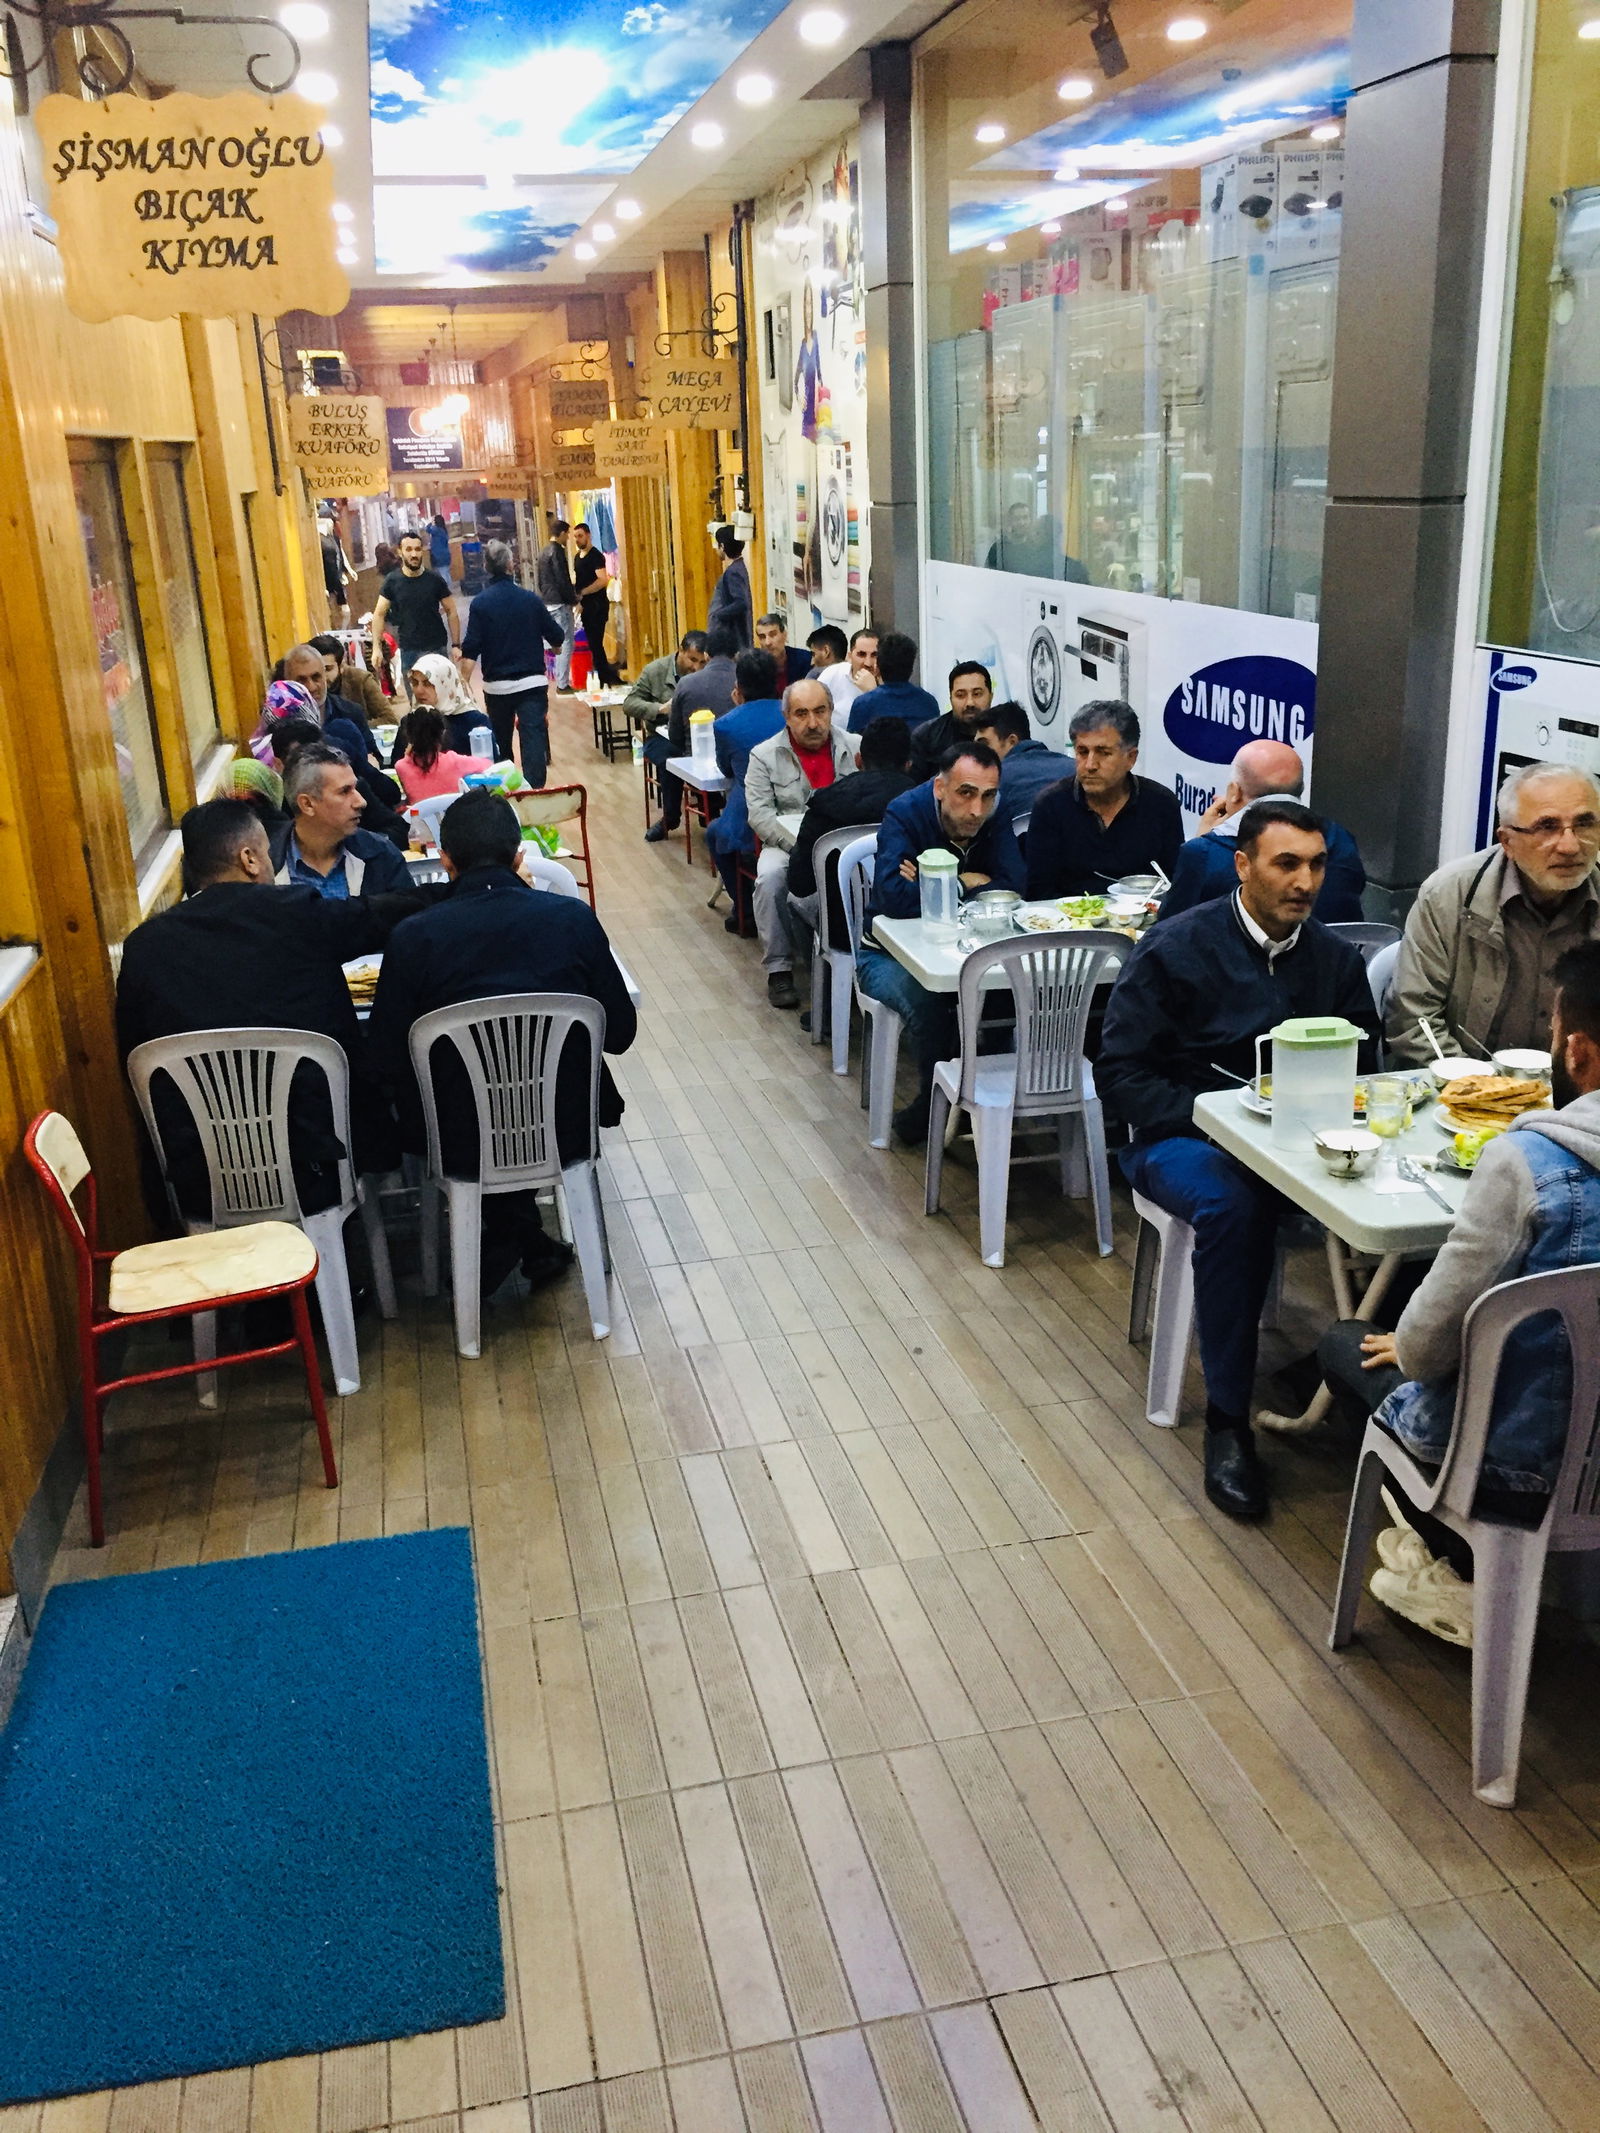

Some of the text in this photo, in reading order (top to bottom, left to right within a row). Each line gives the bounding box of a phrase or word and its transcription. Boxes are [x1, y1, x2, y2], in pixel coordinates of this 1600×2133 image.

[53, 126, 325, 183] ŞİŞMANOĞLU
[1238, 155, 1275, 165] PHILIPS
[1283, 153, 1320, 163] PHILIPS
[134, 187, 264, 232] BIÇAK
[142, 235, 279, 275] KIYMA
[666, 370, 722, 391] MEGA
[307, 403, 368, 422] BULUŞ
[309, 422, 371, 439] ERKEK
[1498, 671, 1533, 686] SAMSUNG
[1181, 676, 1305, 749] SAMSUNG
